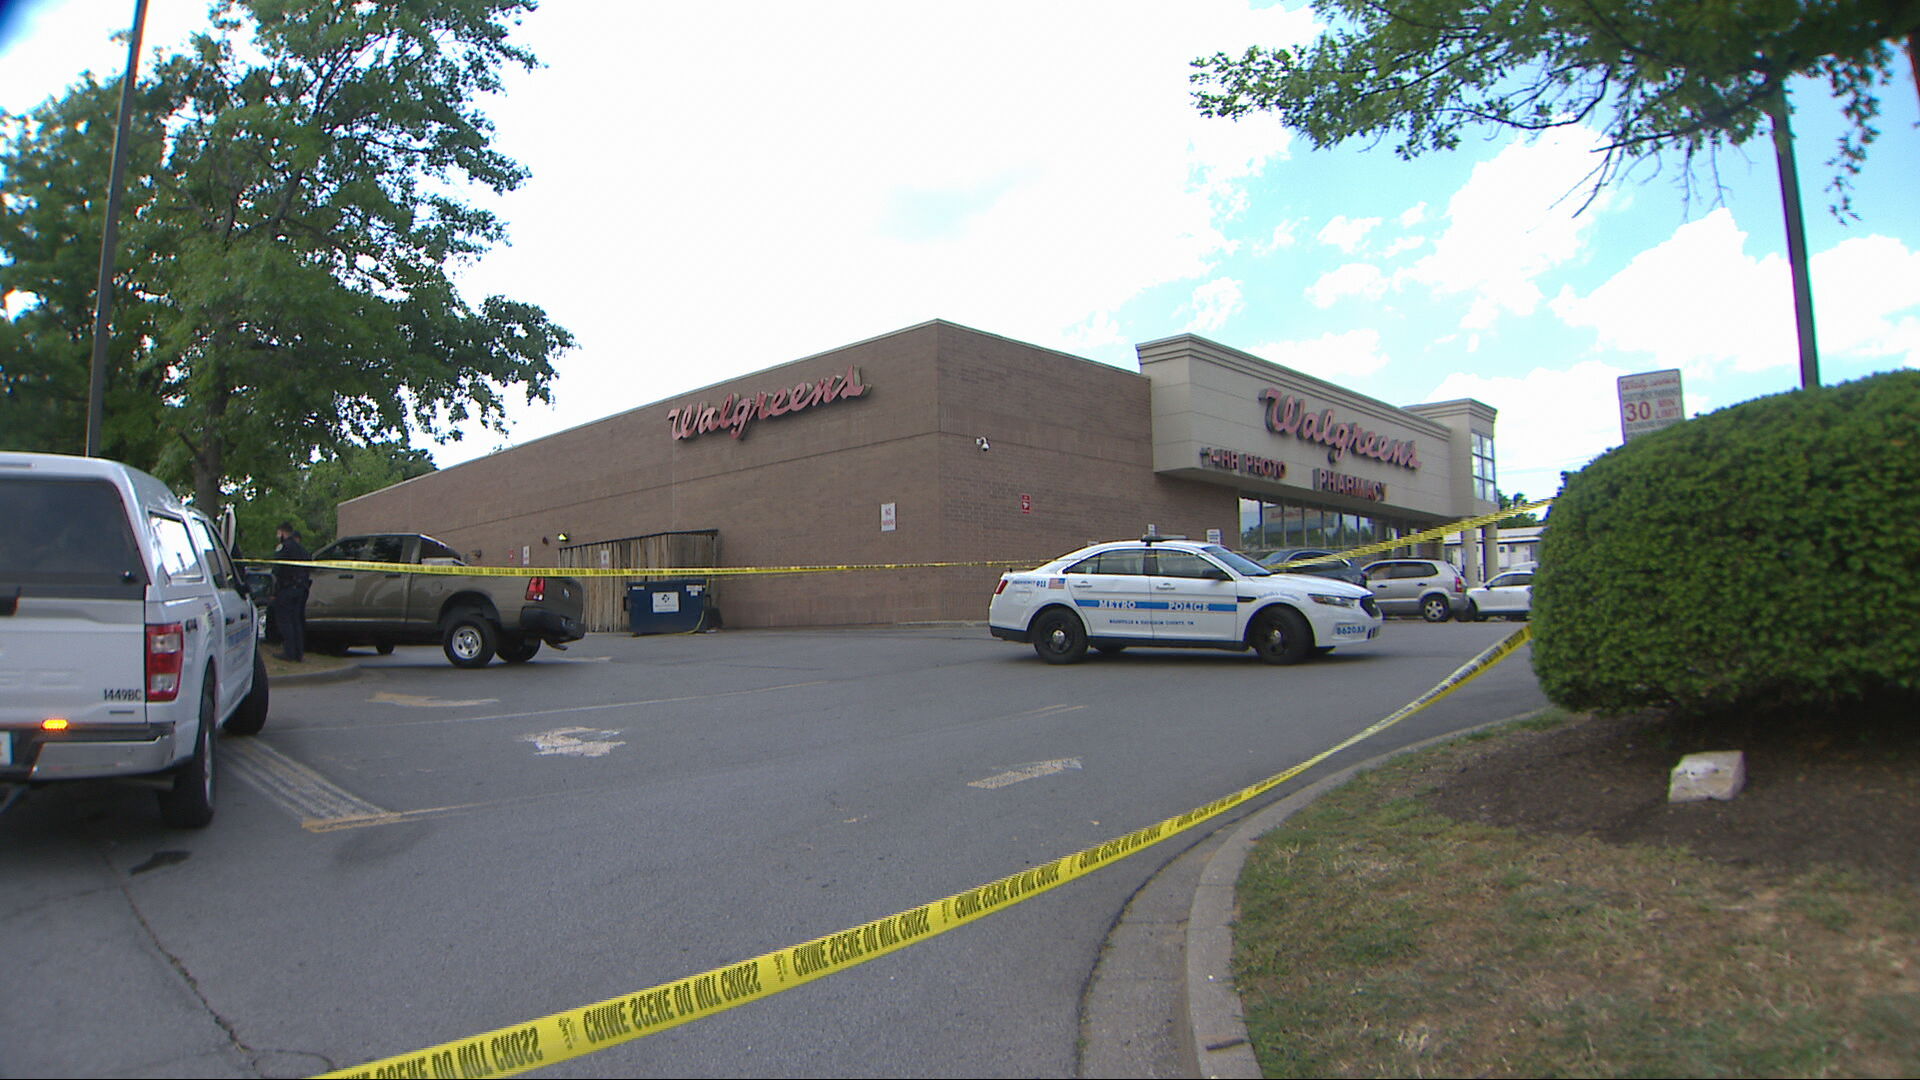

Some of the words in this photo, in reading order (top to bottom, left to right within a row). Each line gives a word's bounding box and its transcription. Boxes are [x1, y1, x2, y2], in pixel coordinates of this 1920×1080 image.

[667, 364, 868, 440] Walgreens
[1625, 401, 1651, 422] 30
[1259, 387, 1422, 469] Walgreens
[1244, 453, 1287, 480] PHOTO
[1316, 468, 1387, 502] PHARMACY
[1098, 599, 1137, 609] METRO
[1168, 602, 1210, 612] POLICE
[104, 687, 142, 701] 1449BC
